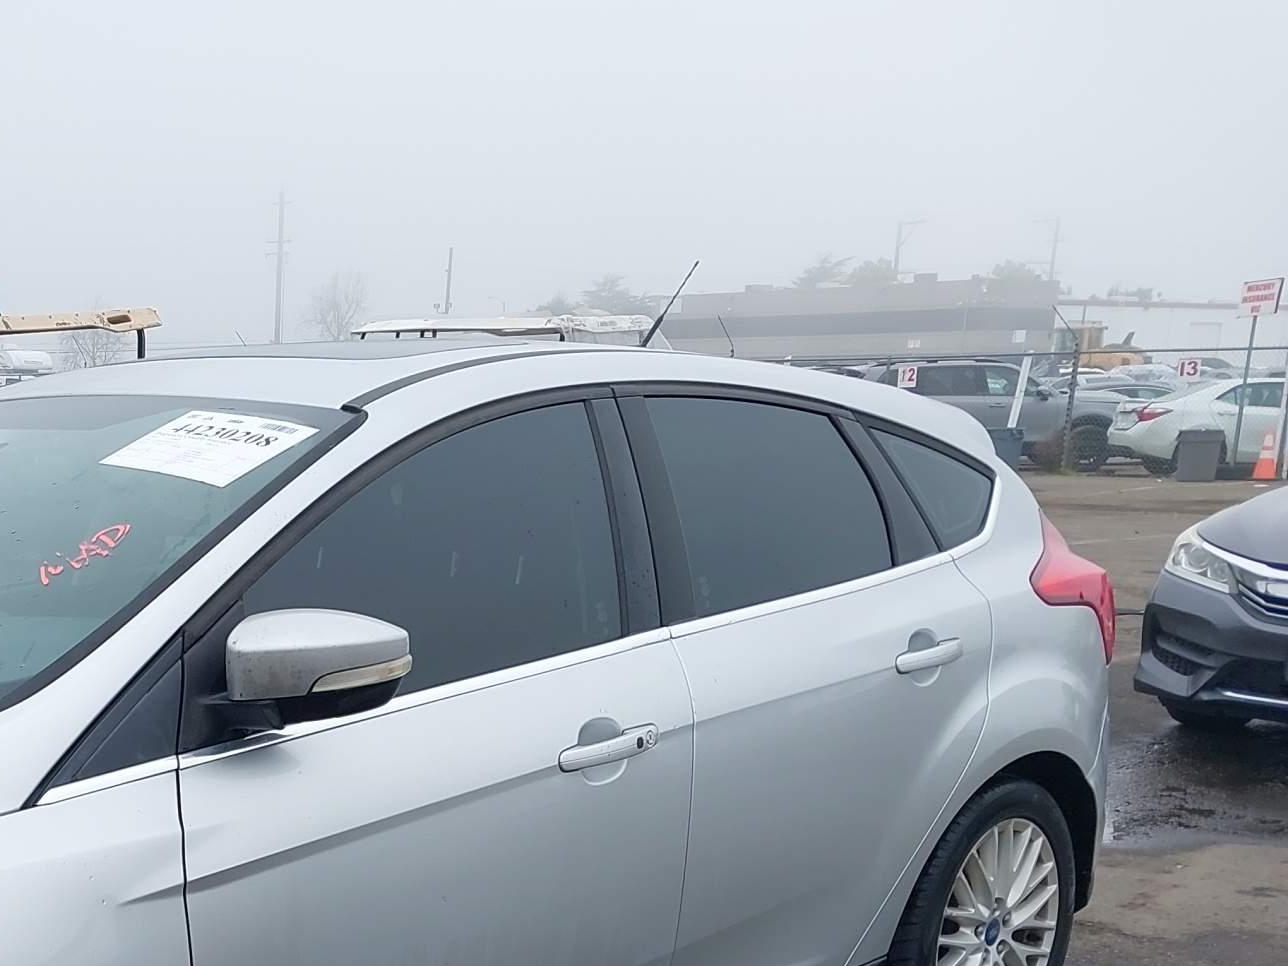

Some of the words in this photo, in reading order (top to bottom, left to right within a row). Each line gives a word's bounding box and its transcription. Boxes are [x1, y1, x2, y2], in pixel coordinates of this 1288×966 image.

[900, 368, 916, 382] 12
[1179, 361, 1199, 377] 13
[171, 423, 279, 447] 44230208
